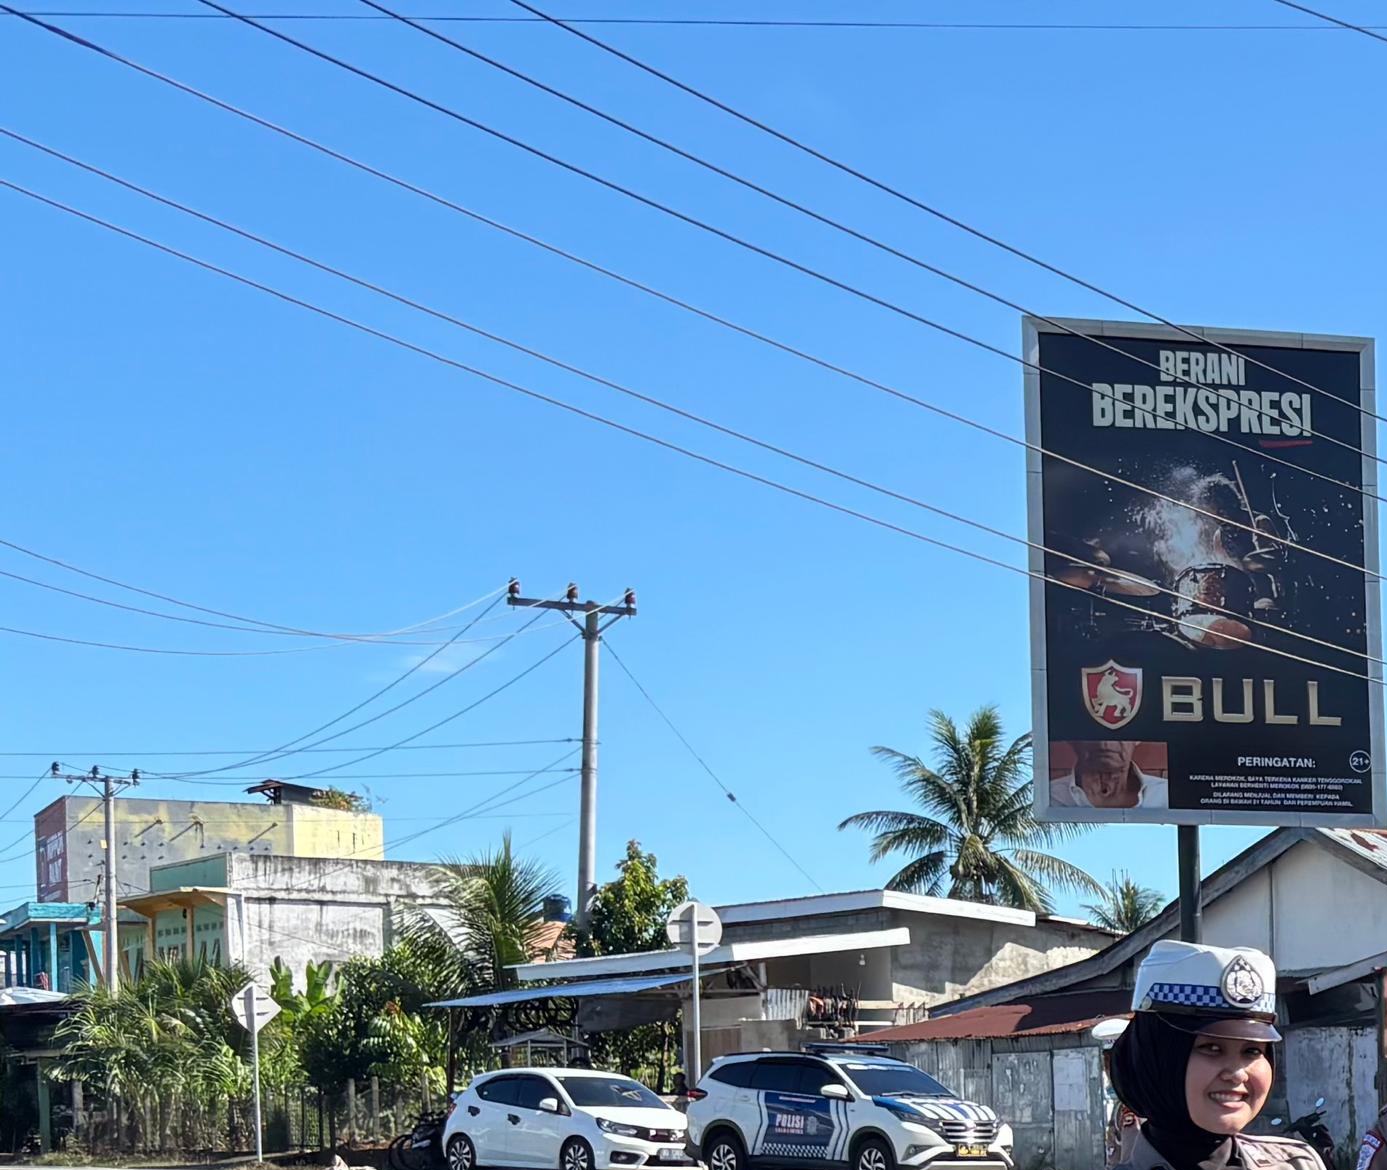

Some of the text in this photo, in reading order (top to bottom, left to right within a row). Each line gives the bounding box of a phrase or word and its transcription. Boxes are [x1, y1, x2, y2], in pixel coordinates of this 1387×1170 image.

[1160, 350, 1246, 386] BERANI
[1092, 382, 1312, 437] BEREKSPRESI
[1161, 676, 1342, 726] BULL
[1237, 756, 1316, 768] PERINGATAN:
[1352, 757, 1370, 766] 21+
[775, 1113, 805, 1128] POLISI
